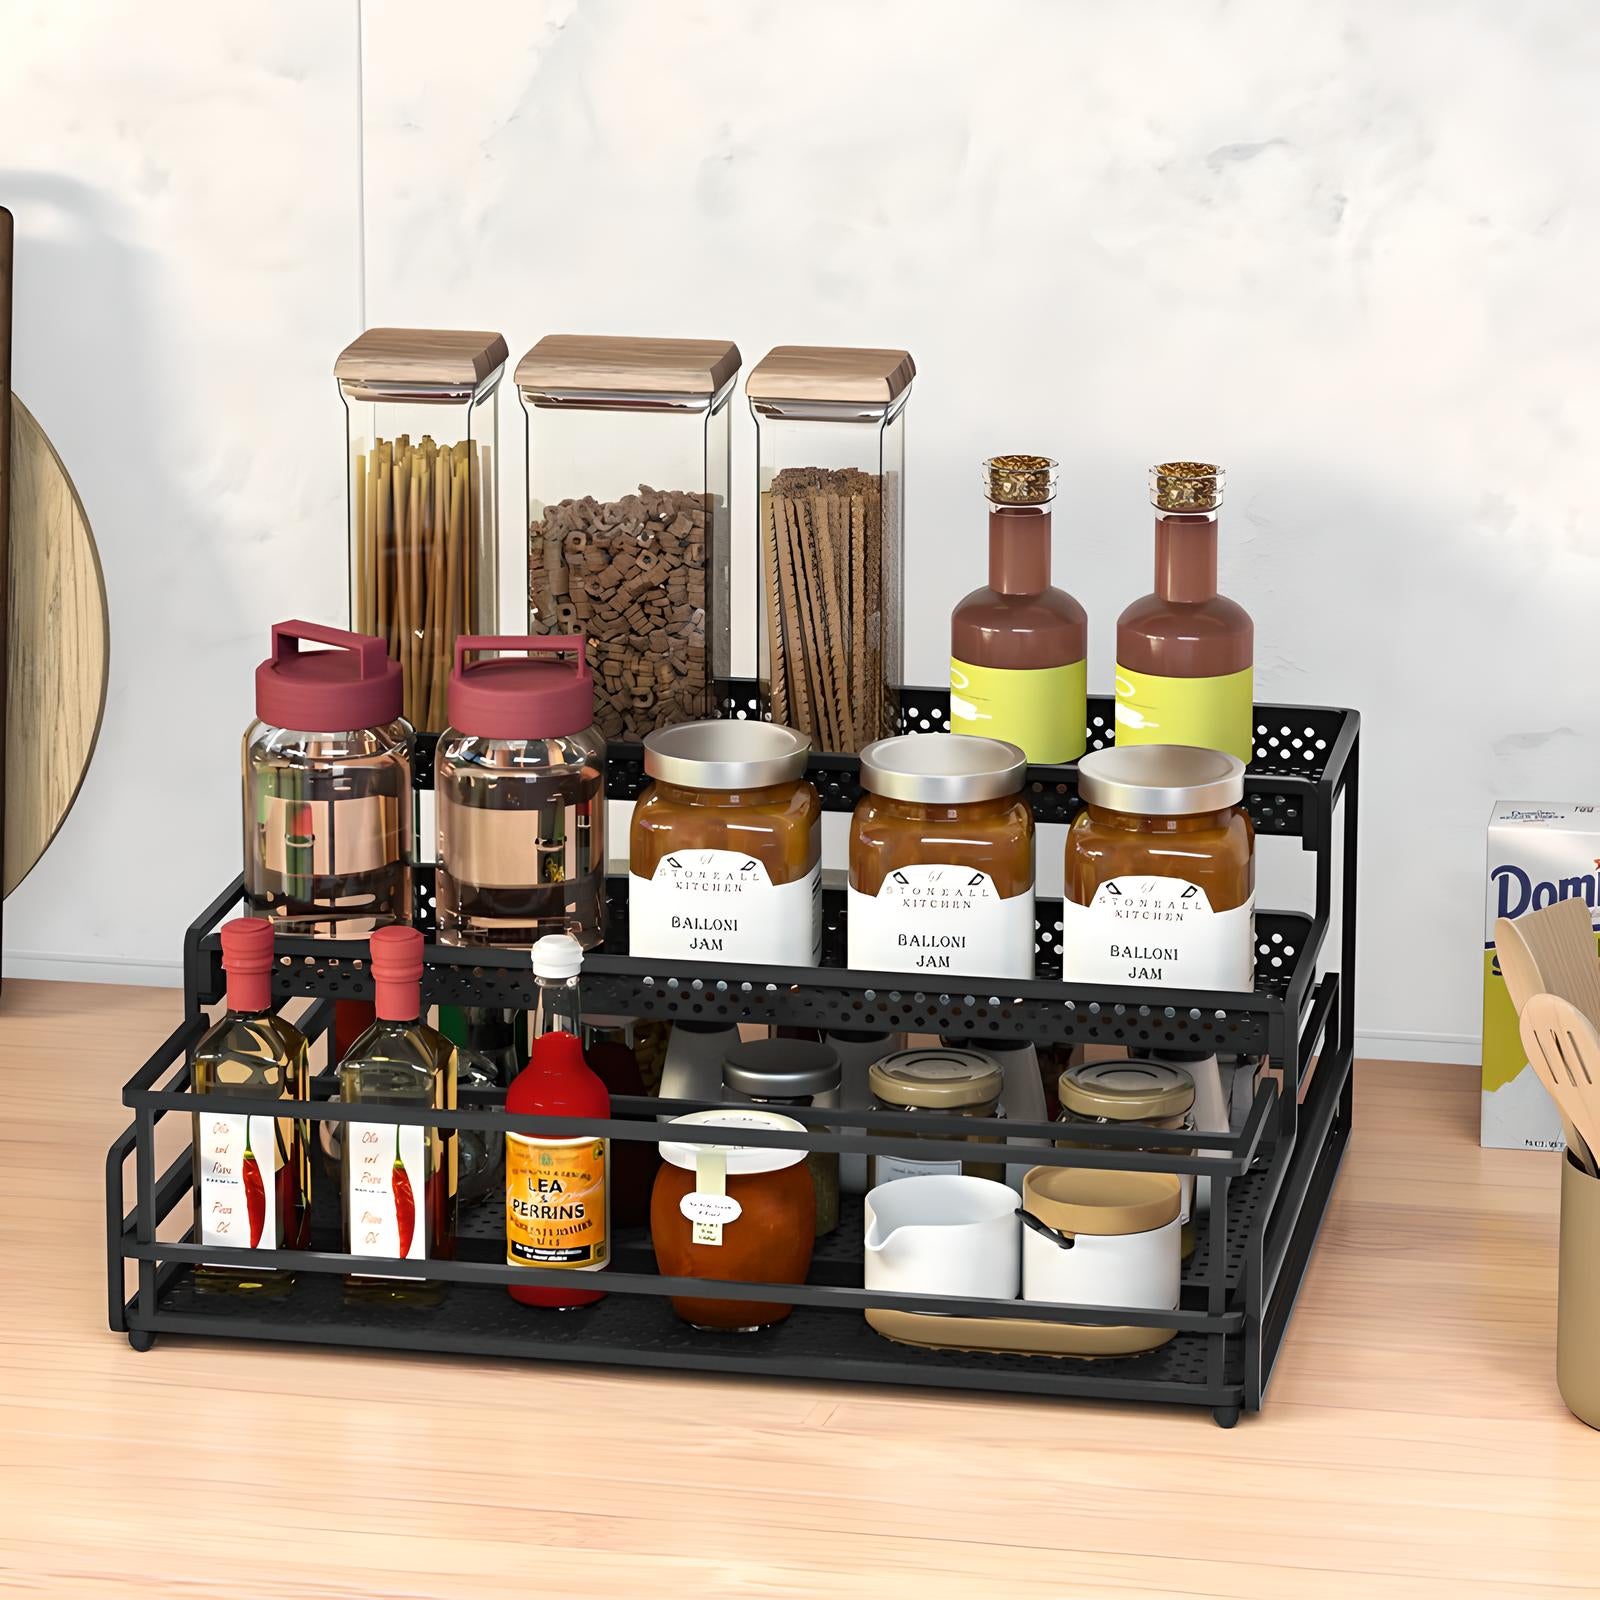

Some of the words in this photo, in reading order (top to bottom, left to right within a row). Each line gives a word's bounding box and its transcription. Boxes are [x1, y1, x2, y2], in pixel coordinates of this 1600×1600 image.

[671, 915, 738, 931] BALLONI
[689, 937, 723, 951] JAM
[898, 933, 966, 948] BALLONI
[1110, 944, 1178, 960] BALLONI
[916, 955, 950, 968] JAM
[1128, 966, 1162, 980] JAM
[528, 1177, 563, 1193] LEA
[512, 1198, 585, 1220] PERRINS
